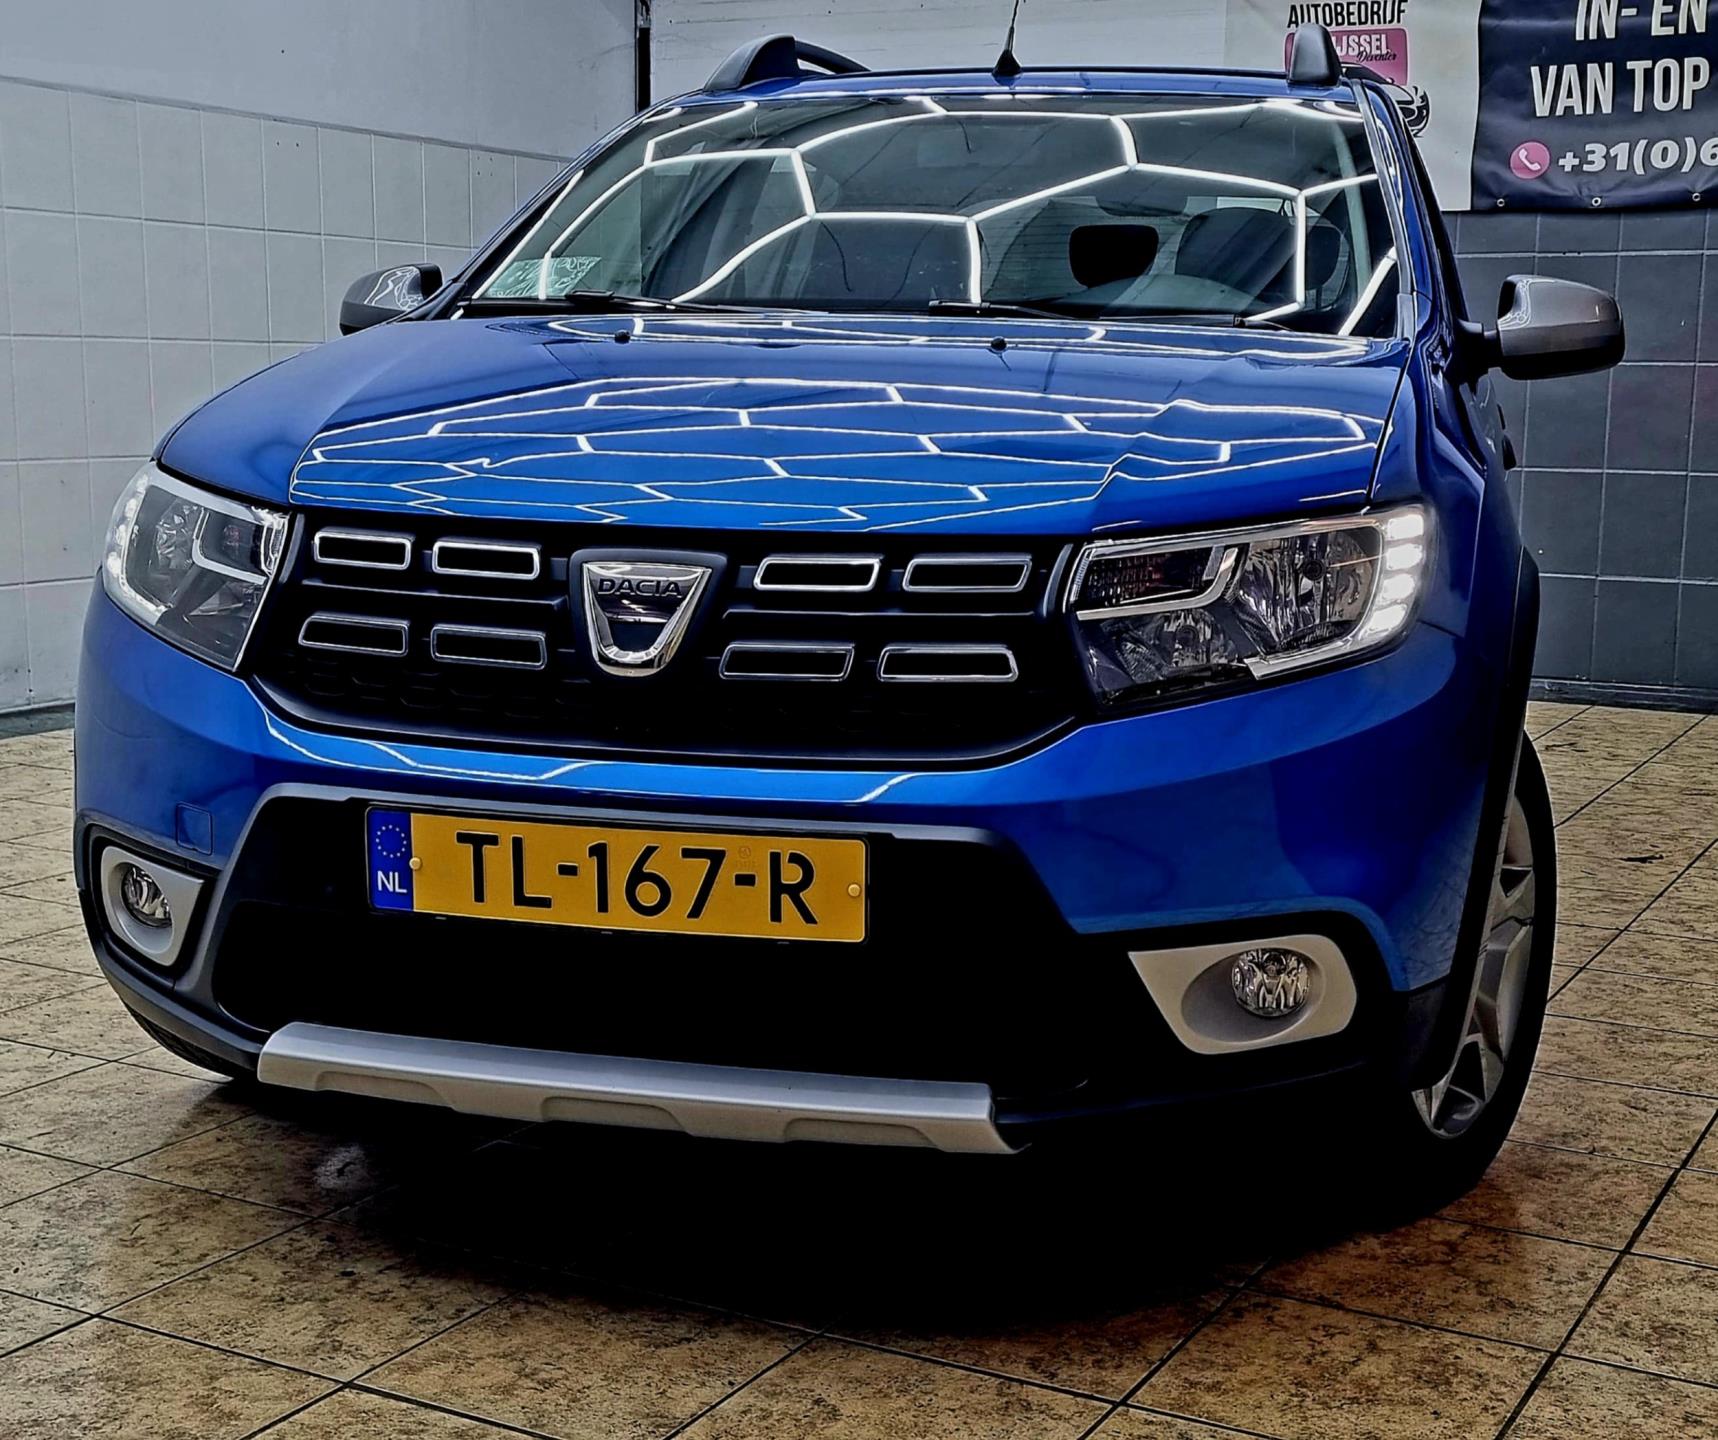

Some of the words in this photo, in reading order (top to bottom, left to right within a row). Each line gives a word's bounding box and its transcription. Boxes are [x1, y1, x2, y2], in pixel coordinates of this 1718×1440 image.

[1286, 0, 1408, 28] AUTOBEDRIJF
[1575, 0, 1637, 41] IN-
[1651, 0, 1708, 36] EN
[1530, 62, 1613, 117] VAN
[1626, 57, 1710, 113] TOP
[1558, 137, 1718, 175] +31(0)6
[597, 578, 682, 598] DACIA
[377, 870, 408, 893] NL
[456, 831, 818, 925] TL-167-R
